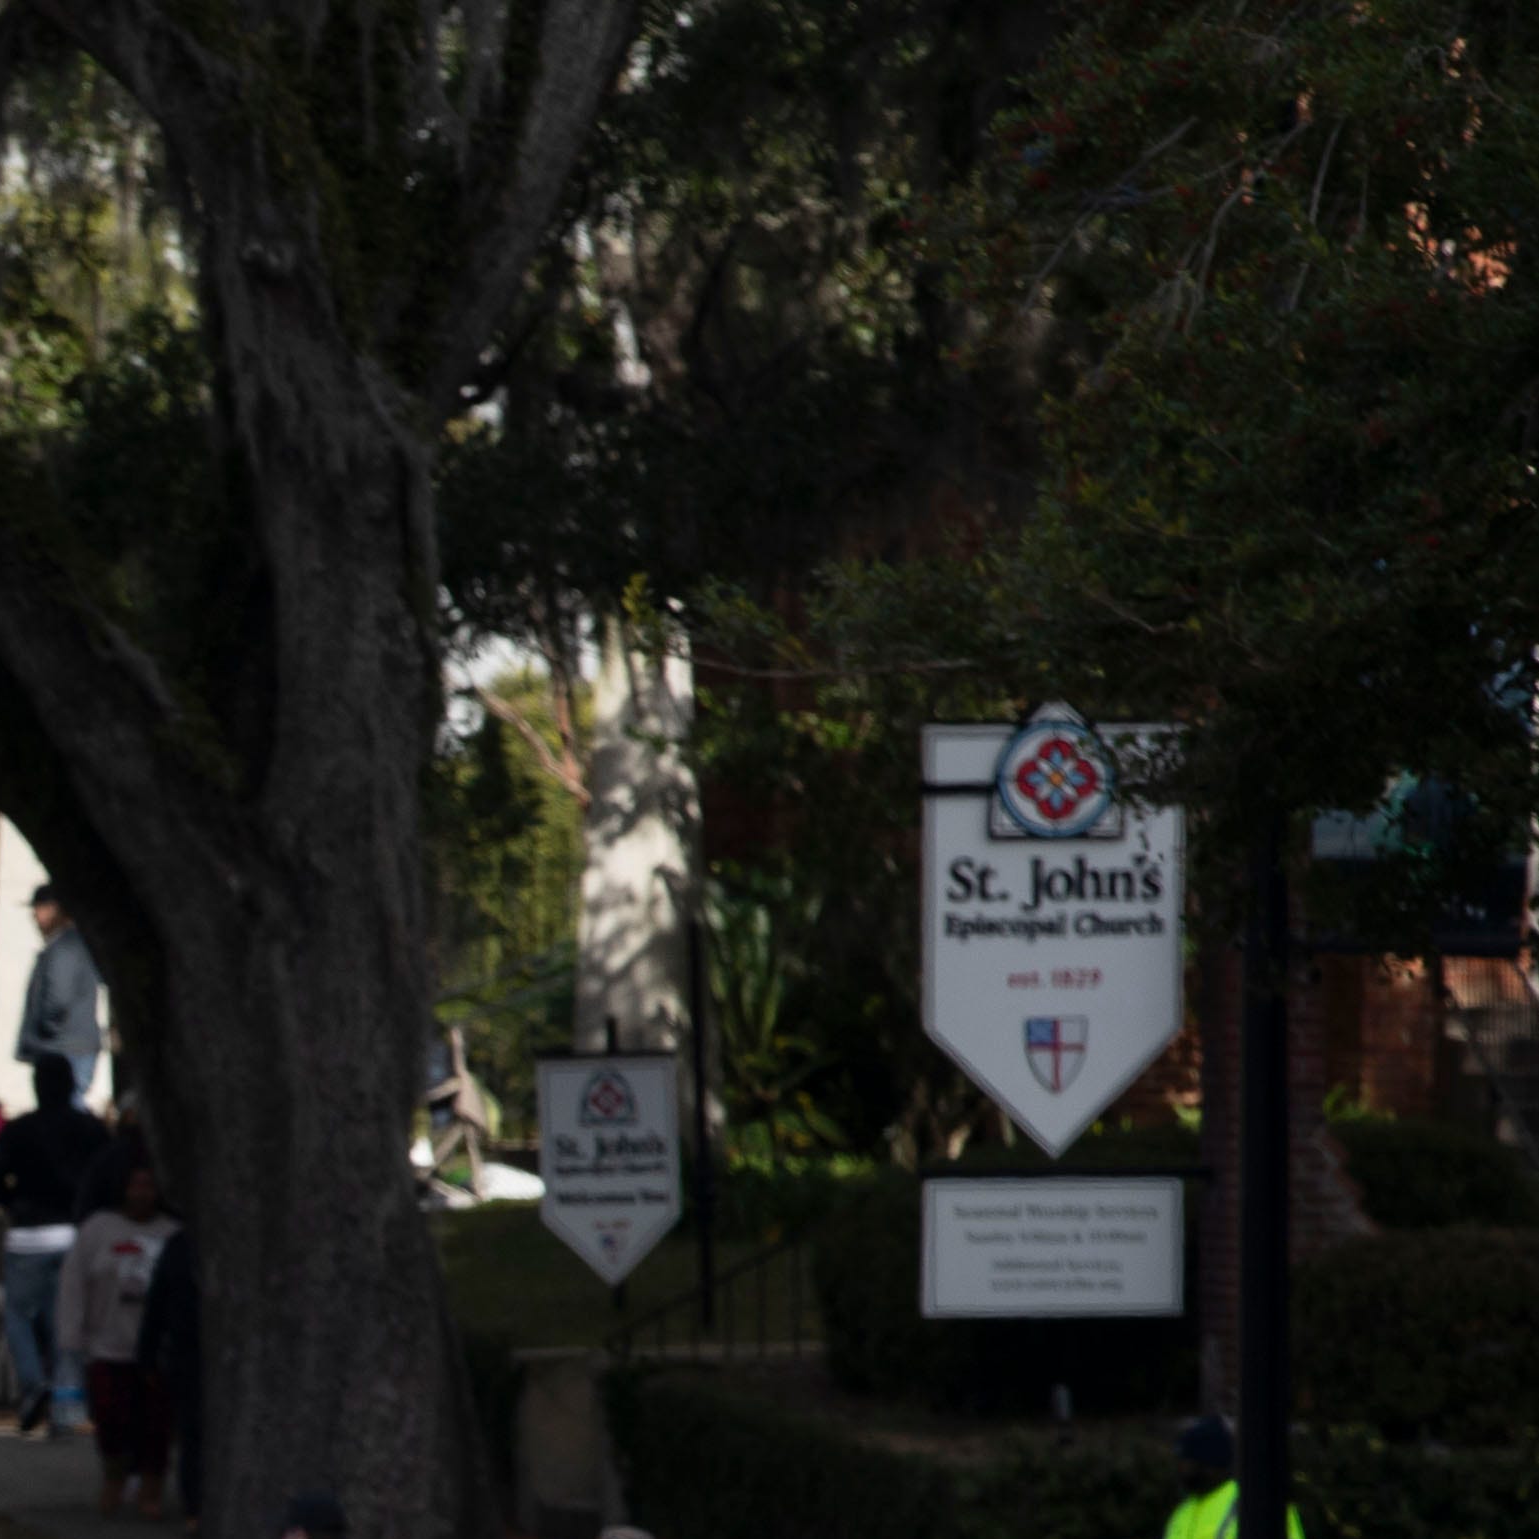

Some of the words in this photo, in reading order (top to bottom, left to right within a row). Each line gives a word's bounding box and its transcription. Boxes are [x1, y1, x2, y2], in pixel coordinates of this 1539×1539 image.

[947, 855, 1010, 903] St.
[945, 911, 1067, 944] Episcopal
[1075, 911, 1165, 938] Church
